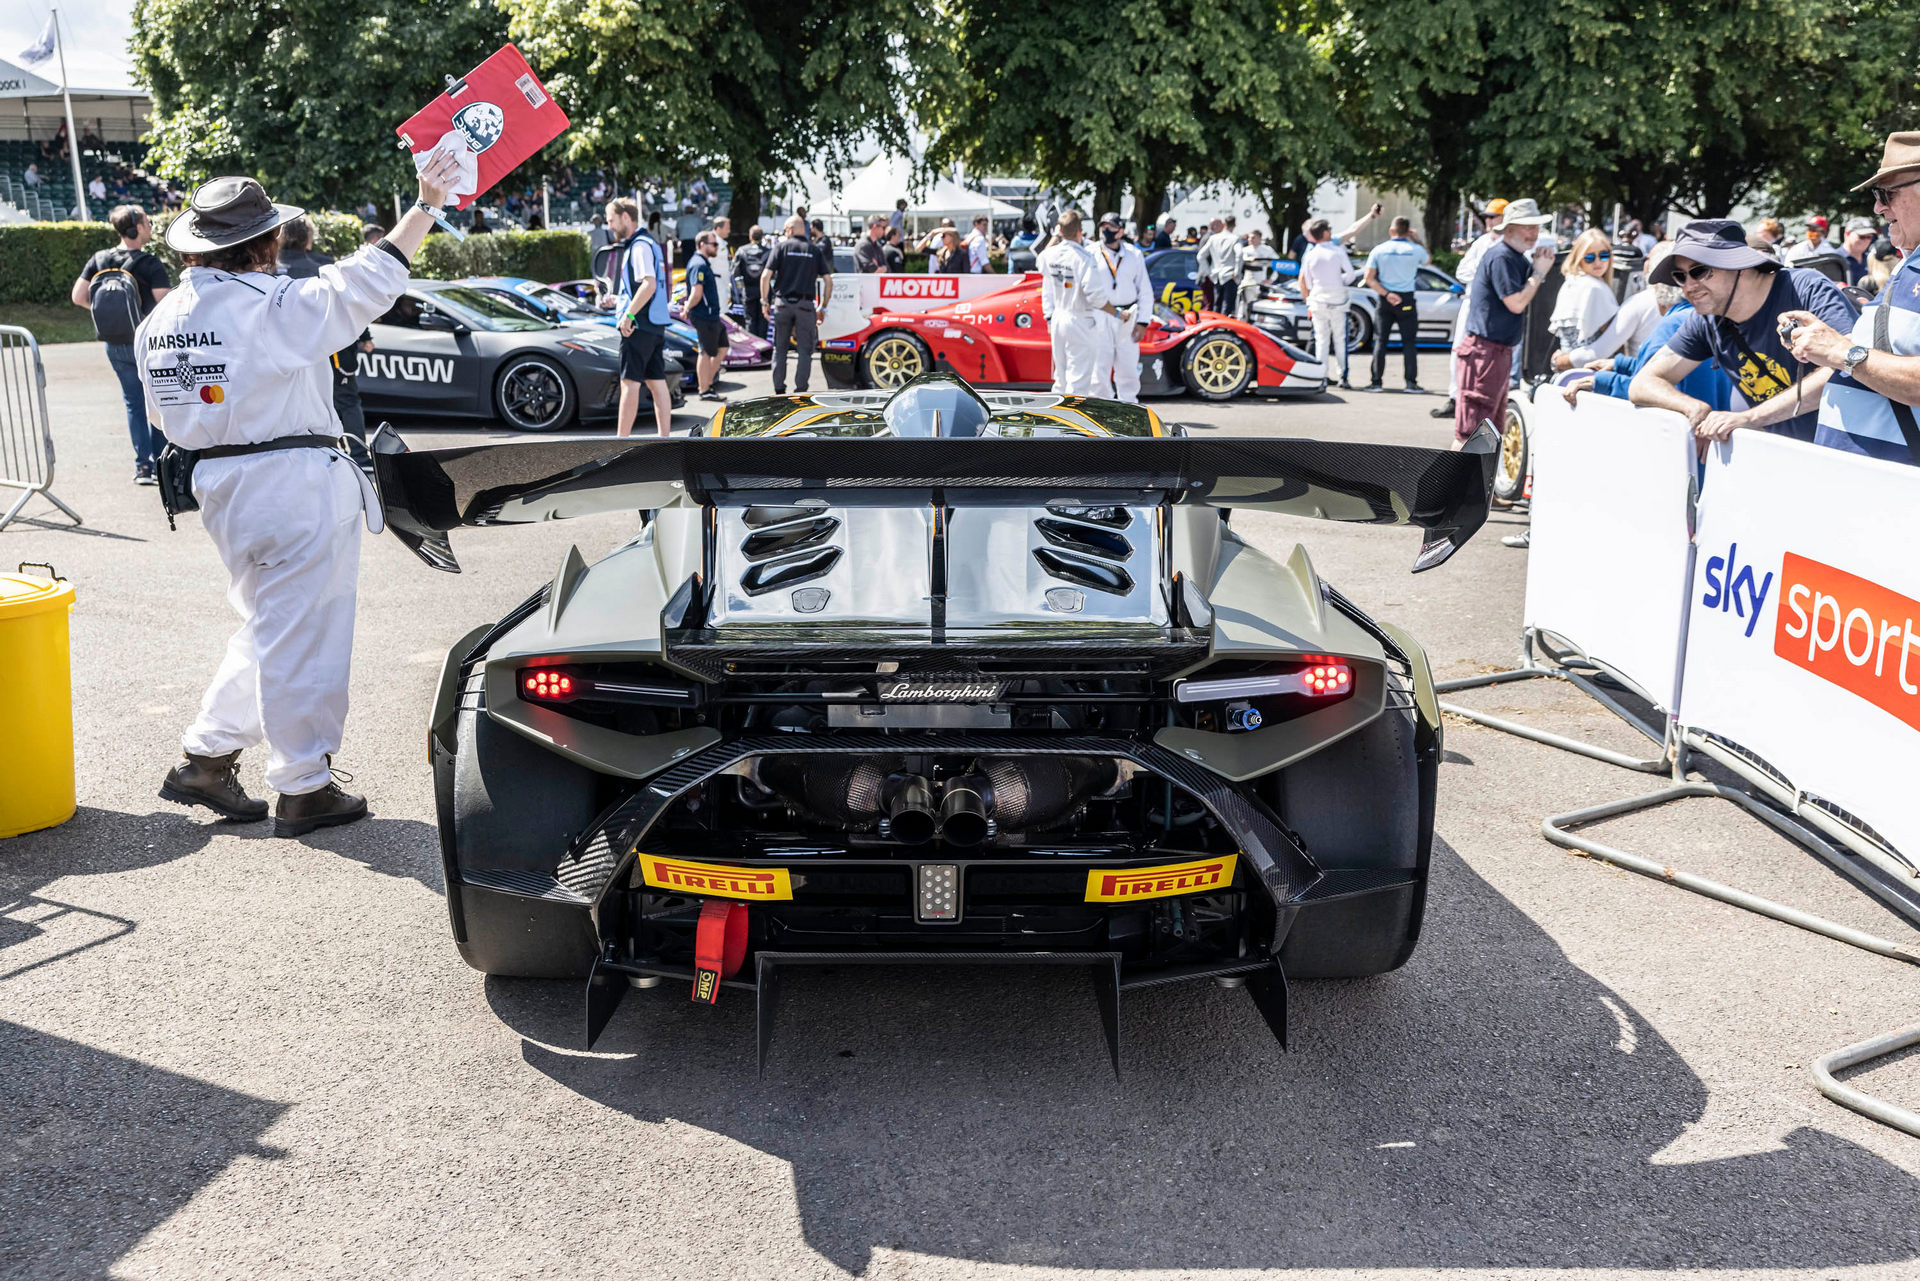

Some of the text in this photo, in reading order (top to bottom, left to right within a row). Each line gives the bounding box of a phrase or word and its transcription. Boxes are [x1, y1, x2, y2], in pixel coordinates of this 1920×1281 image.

[455, 117, 482, 149] BARC
[882, 280, 956, 297] MOTUL
[148, 331, 222, 351] MARSHAL
[355, 353, 454, 383] ARROW
[1703, 543, 1773, 637] sky
[880, 683, 997, 701] Lamborghini
[653, 862, 775, 894] PIRELLI
[1100, 863, 1224, 896] PIRELLI
[700, 971, 712, 999] OMP
